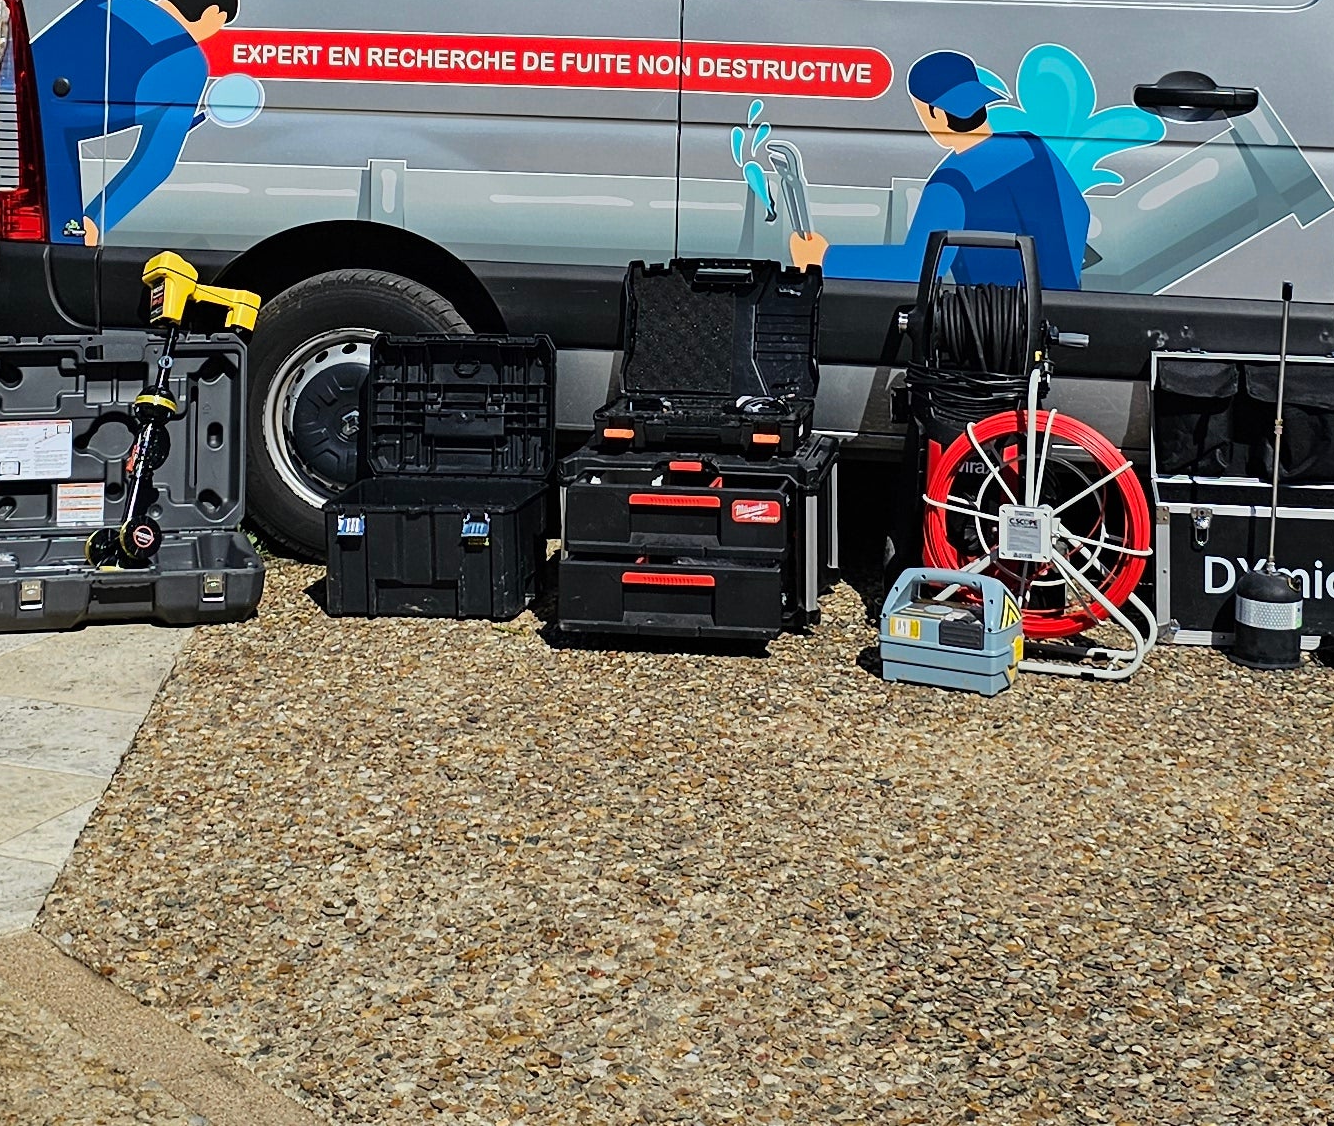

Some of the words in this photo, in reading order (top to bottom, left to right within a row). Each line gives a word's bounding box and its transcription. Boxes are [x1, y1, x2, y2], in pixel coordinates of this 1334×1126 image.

[232, 43, 323, 65] EXPERT
[327, 45, 361, 67] EN
[366, 47, 517, 72] RECHERCHE
[522, 51, 556, 73] DE
[561, 52, 632, 74] FUITE
[637, 54, 692, 77] NON
[698, 56, 873, 84] DESTRUCTIVE
